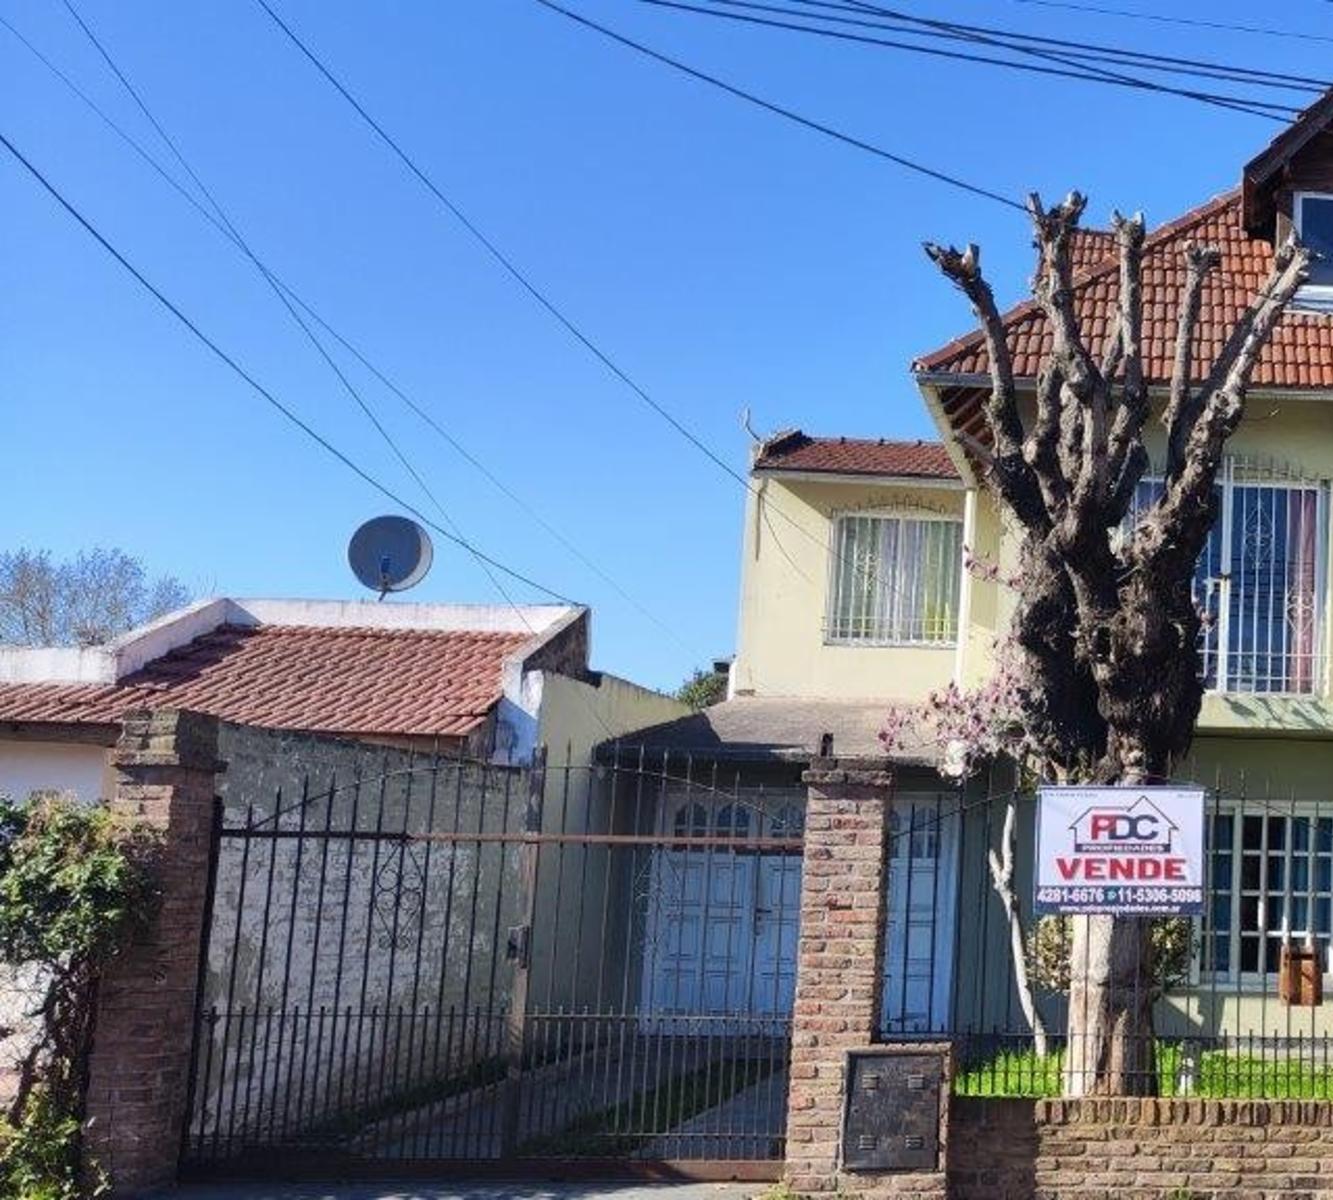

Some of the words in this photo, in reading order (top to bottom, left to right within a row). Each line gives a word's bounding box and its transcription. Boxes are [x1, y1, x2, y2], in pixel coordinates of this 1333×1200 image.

[1090, 814, 1159, 841] PDC
[1056, 857, 1186, 881] VENDE
[1037, 887, 1104, 903] 4281-6676
